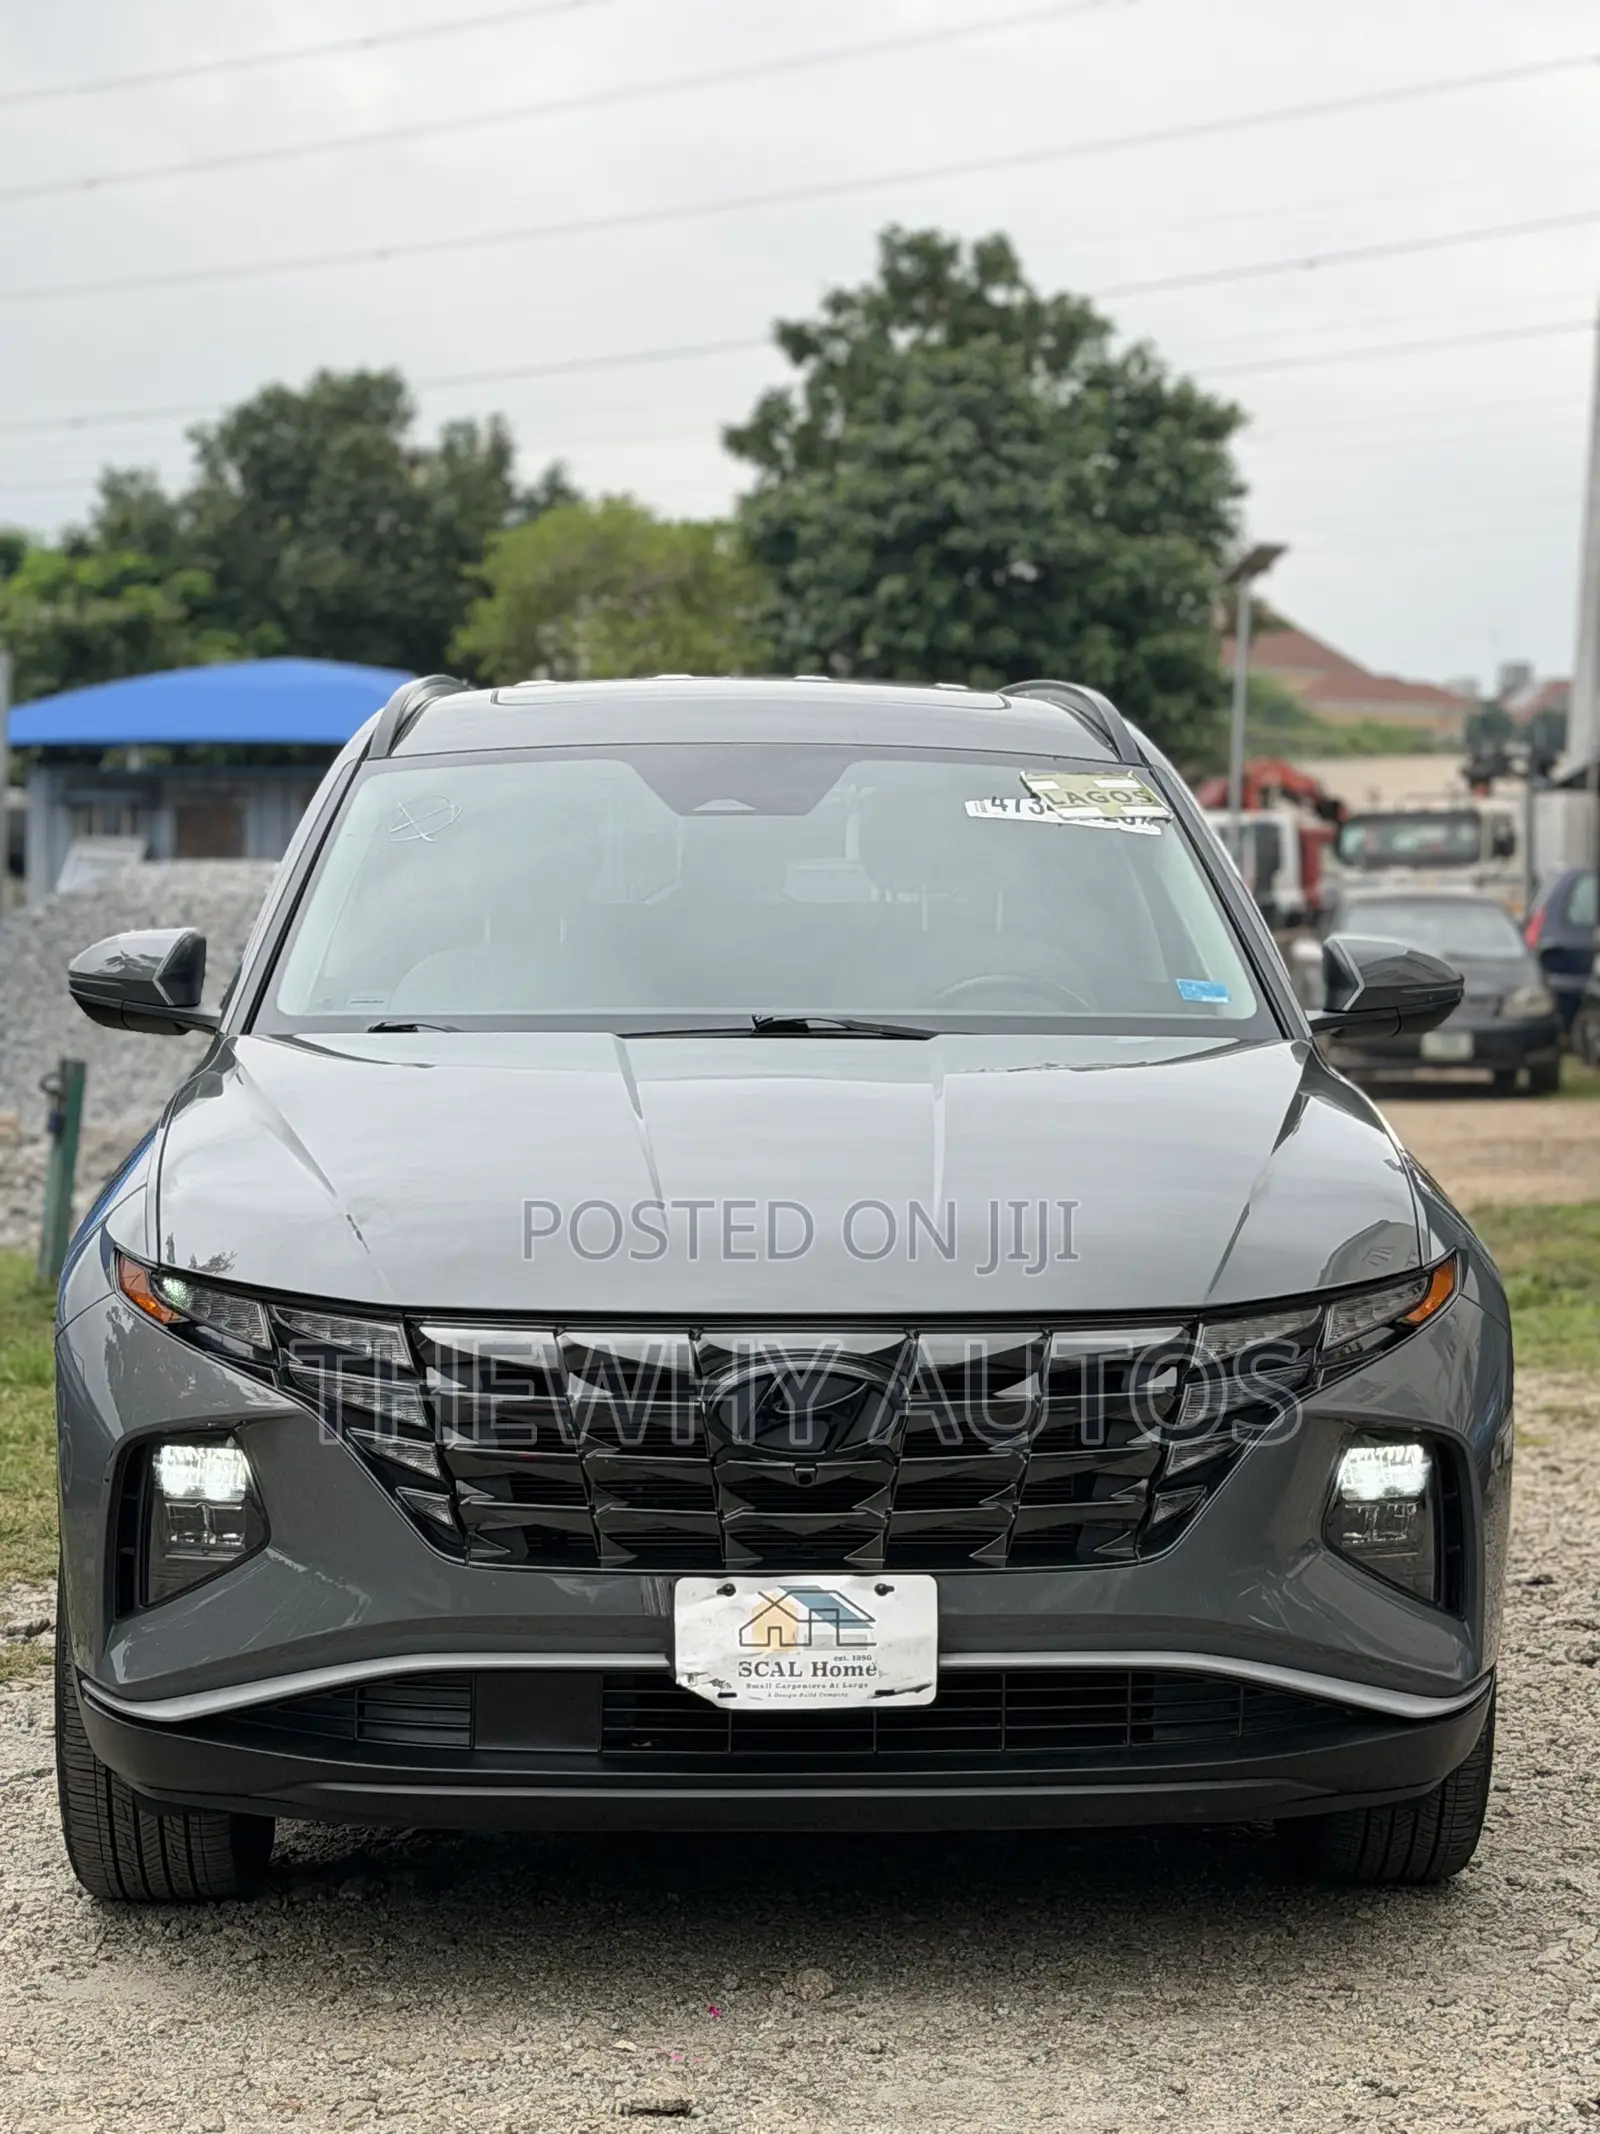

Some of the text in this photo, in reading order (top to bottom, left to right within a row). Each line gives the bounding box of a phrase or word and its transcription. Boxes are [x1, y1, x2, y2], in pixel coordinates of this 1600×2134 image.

[1042, 789, 1154, 806] LAGOS
[738, 1661, 877, 1677] SCAL Home
[775, 1682, 826, 1690] Carpenters
[842, 1681, 868, 1689] Large
